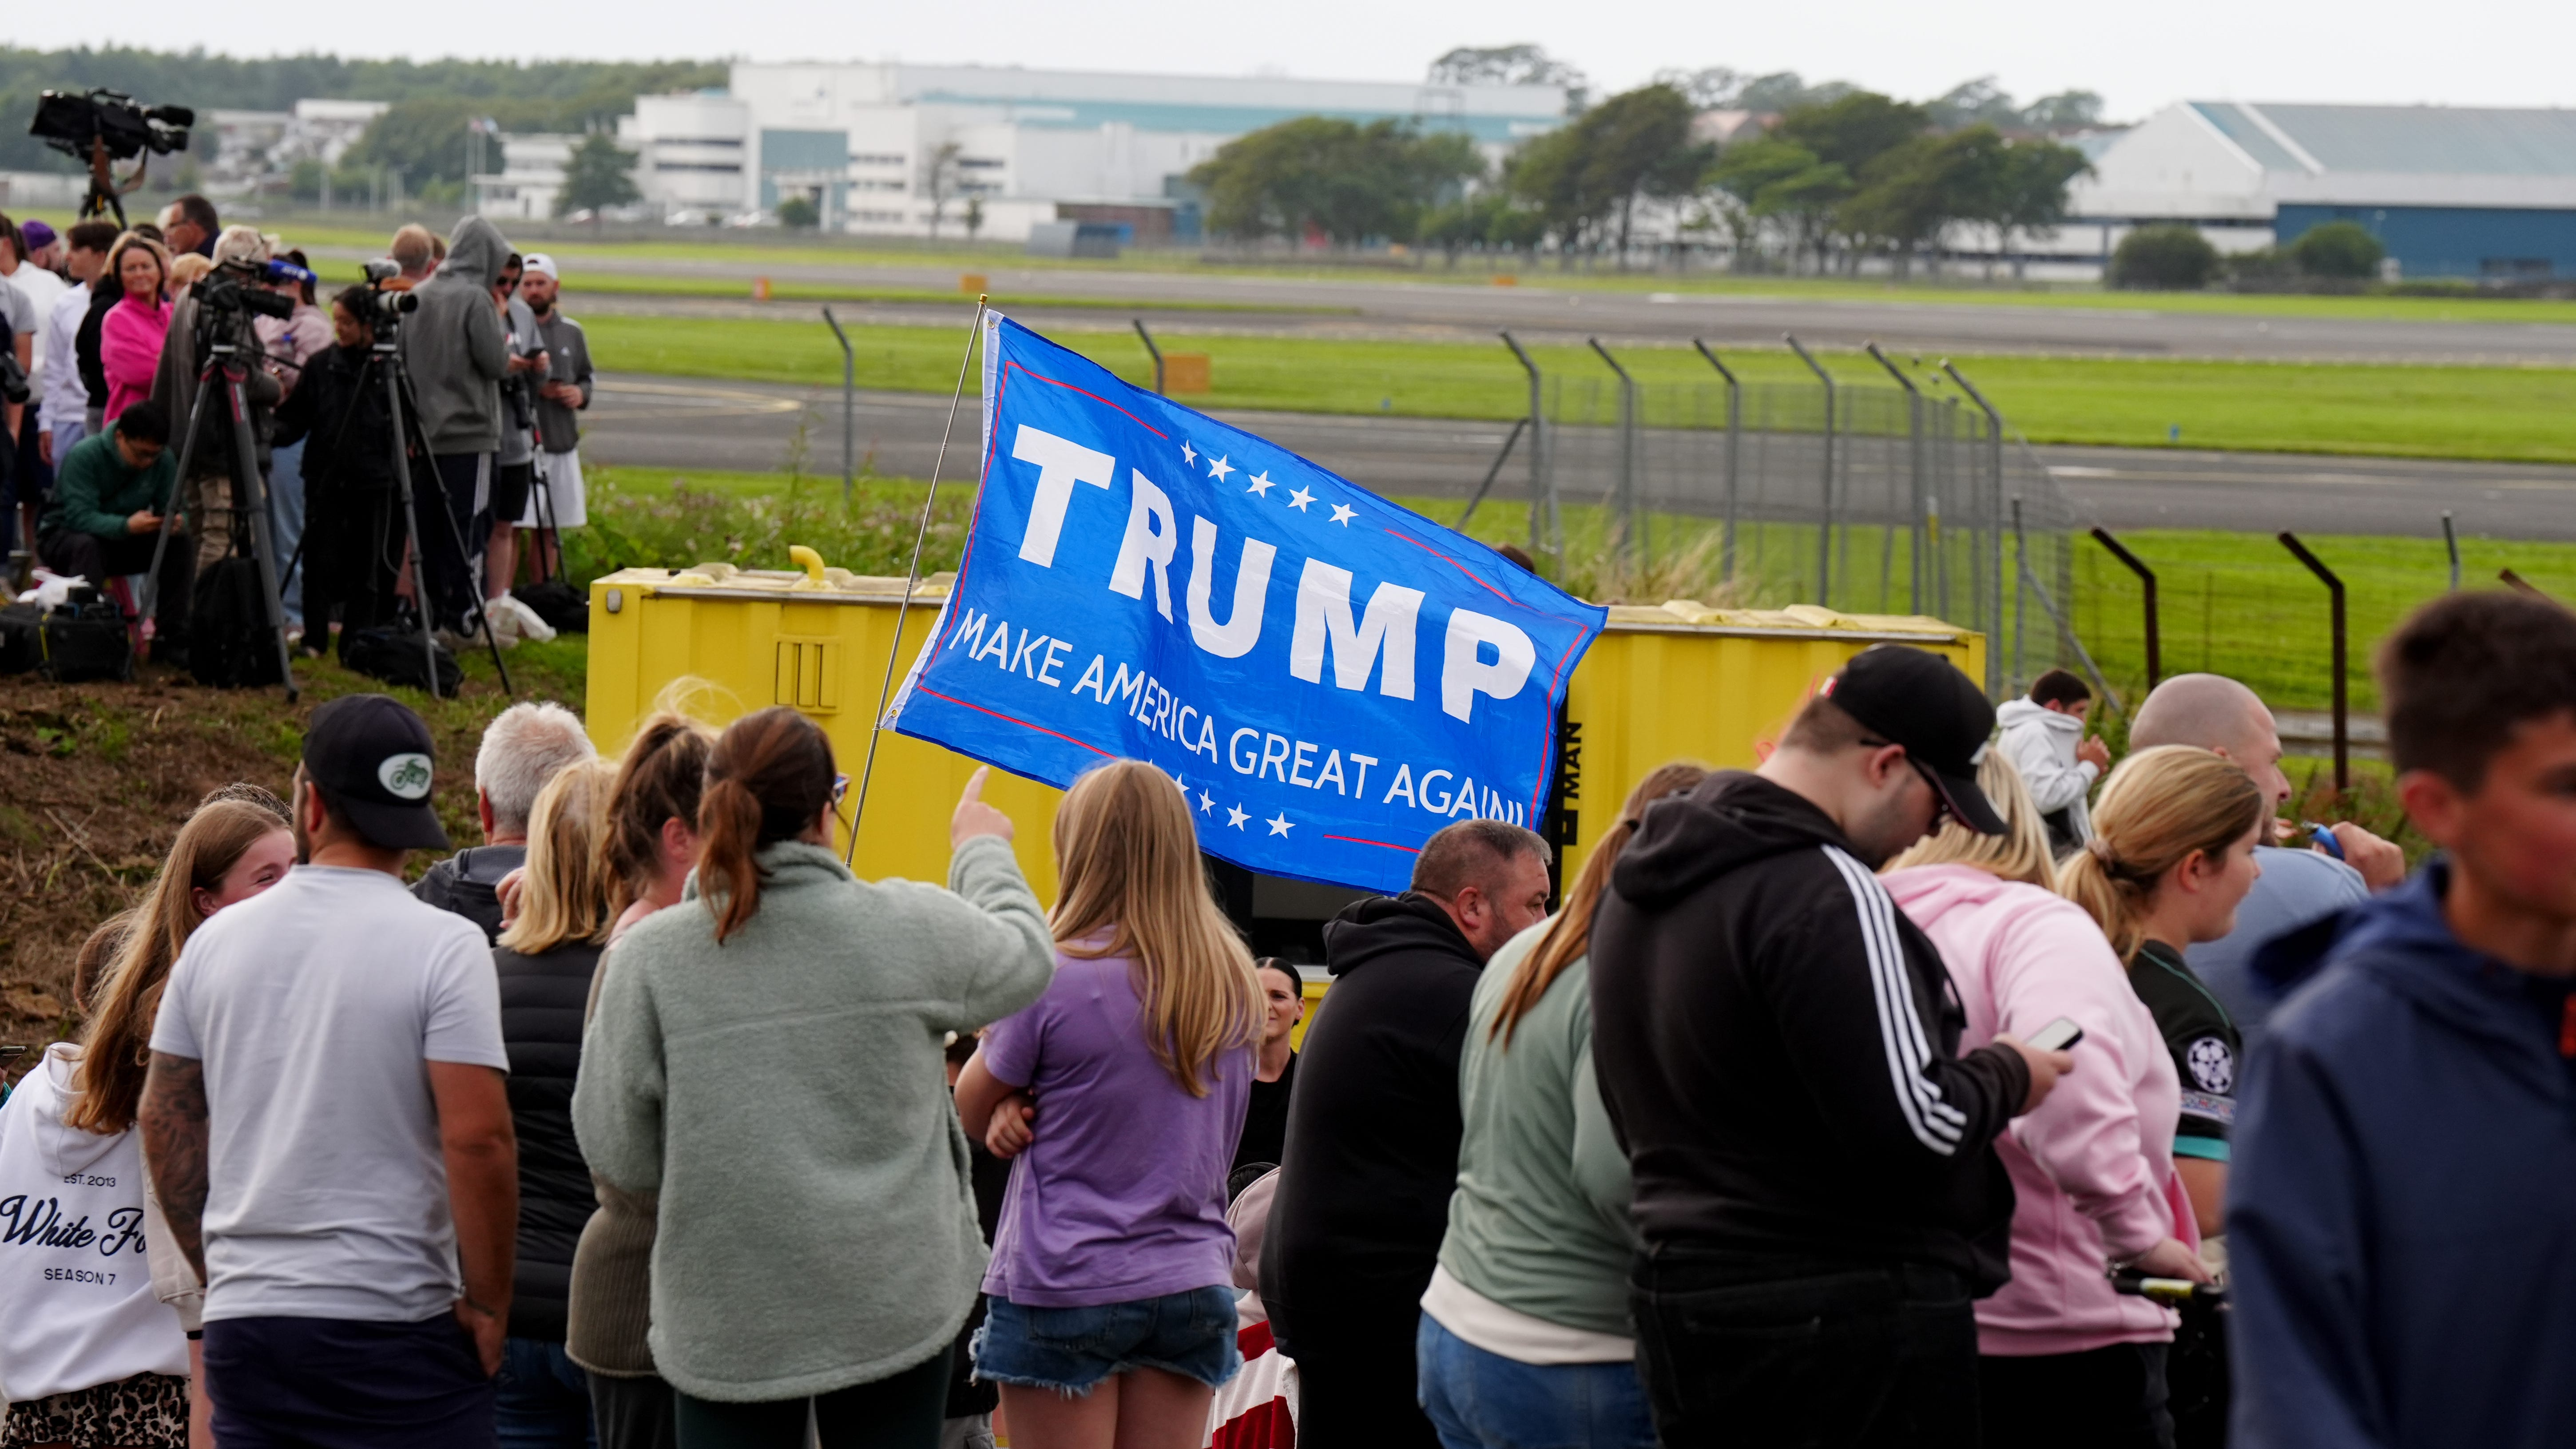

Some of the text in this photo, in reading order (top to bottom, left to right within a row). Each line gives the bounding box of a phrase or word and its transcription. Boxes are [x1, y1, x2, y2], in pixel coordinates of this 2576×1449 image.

[1012, 424, 1536, 724] TRUMP
[948, 607, 1073, 687] MAKE
[1071, 654, 1217, 764] AMERICA
[1230, 728, 1378, 799] GREAT
[64, 1173, 116, 1187] EST. 2013
[0, 1195, 146, 1256] White Fo
[44, 1267, 116, 1286] SEASON 7
